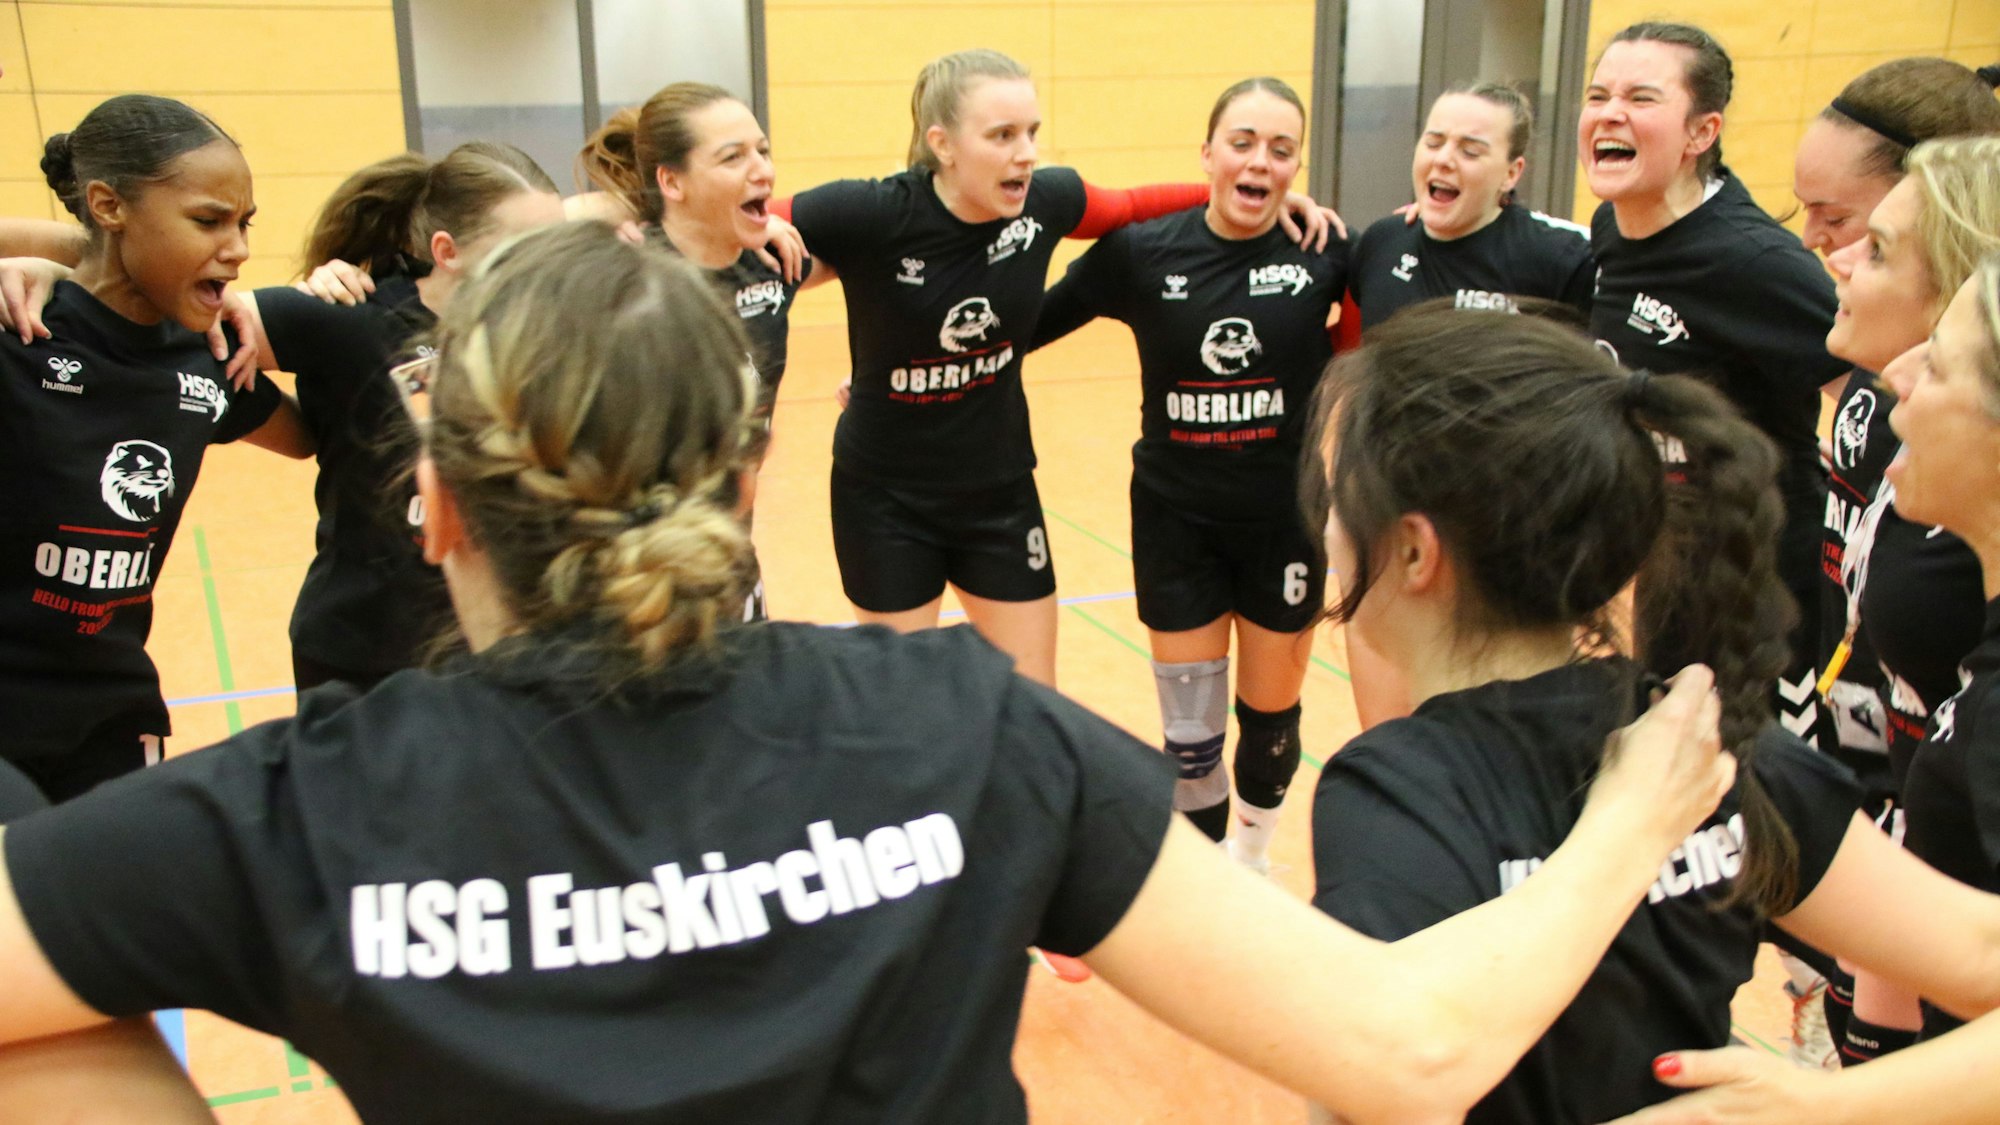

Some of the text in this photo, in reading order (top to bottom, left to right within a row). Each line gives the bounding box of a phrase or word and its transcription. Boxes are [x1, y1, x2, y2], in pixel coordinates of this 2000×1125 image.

[1249, 264, 1297, 286] HSG
[736, 281, 777, 308] HSG
[1455, 289, 1506, 311] HSG
[1632, 292, 1673, 328] HSG
[41, 378, 84, 394] hummel
[177, 371, 218, 401] HSG
[1166, 388, 1284, 423] OBERLIGA
[1027, 526, 1047, 571] 9
[1283, 562, 1308, 606] 6
[32, 588, 70, 612] HELLO
[351, 812, 965, 979] HSG Euskirchen
